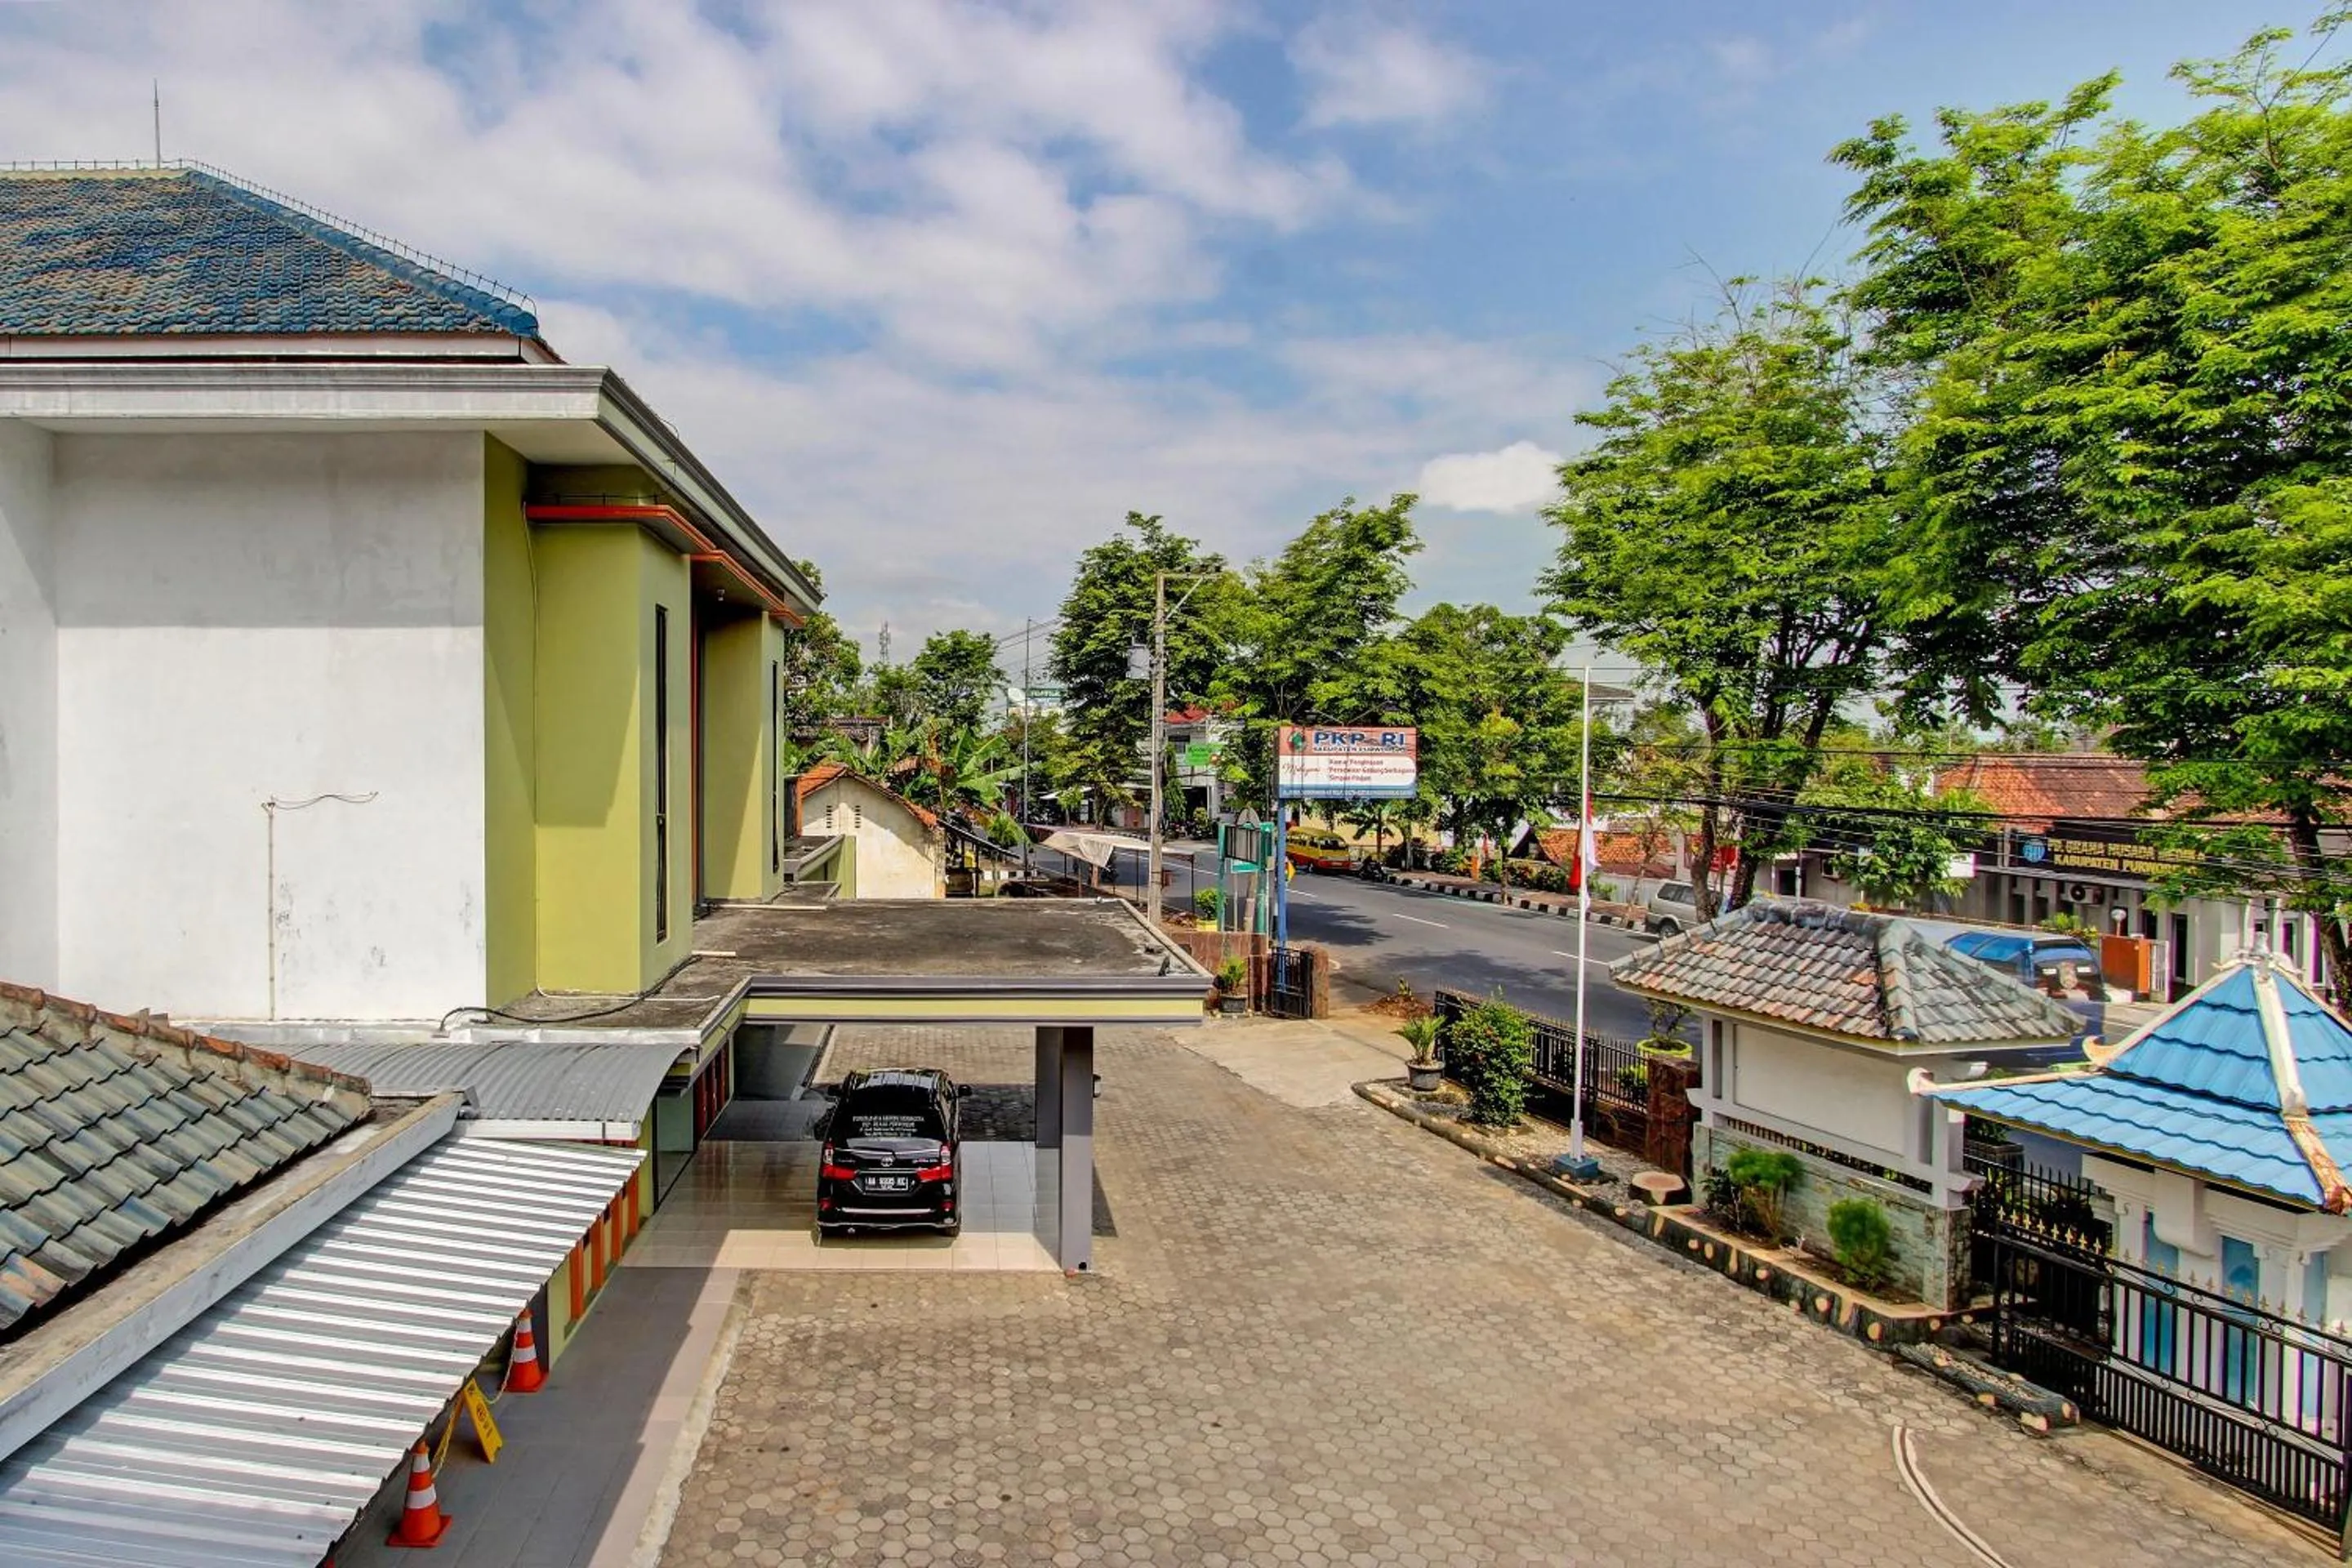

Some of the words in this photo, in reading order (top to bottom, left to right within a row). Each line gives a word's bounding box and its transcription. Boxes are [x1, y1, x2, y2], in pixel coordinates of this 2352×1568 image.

[1314, 731, 1365, 745] PKP
[1381, 732, 1405, 746] RI
[2053, 853, 2120, 871] KABUPATEN
